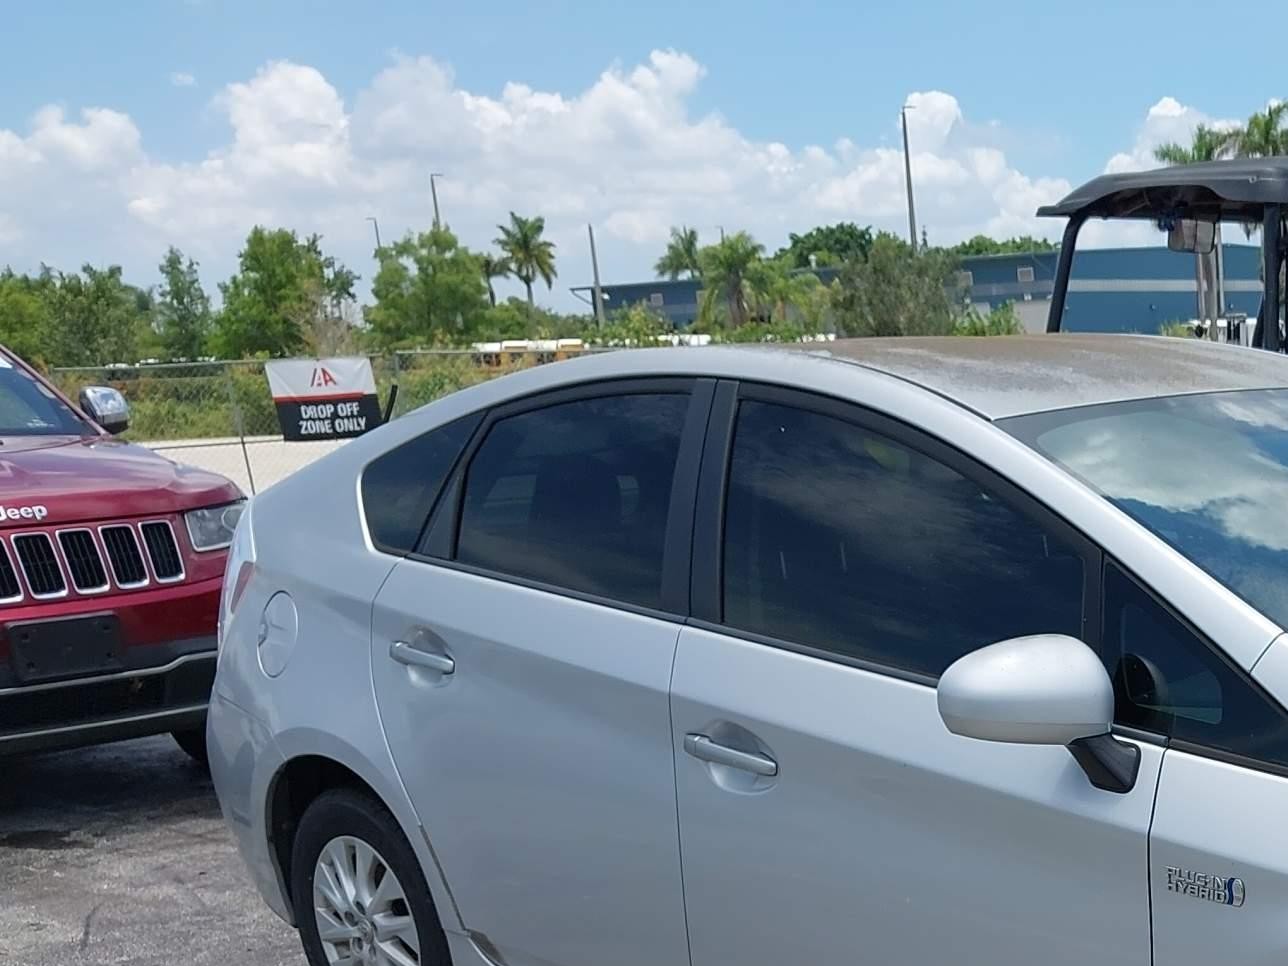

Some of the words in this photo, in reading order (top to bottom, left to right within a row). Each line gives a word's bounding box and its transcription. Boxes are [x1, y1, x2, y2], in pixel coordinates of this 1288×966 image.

[300, 404, 334, 419] DROP
[337, 402, 360, 416] OFF
[299, 420, 333, 434] ZONE
[335, 416, 366, 432] ONLY
[1167, 882, 1227, 904] HYBRID
